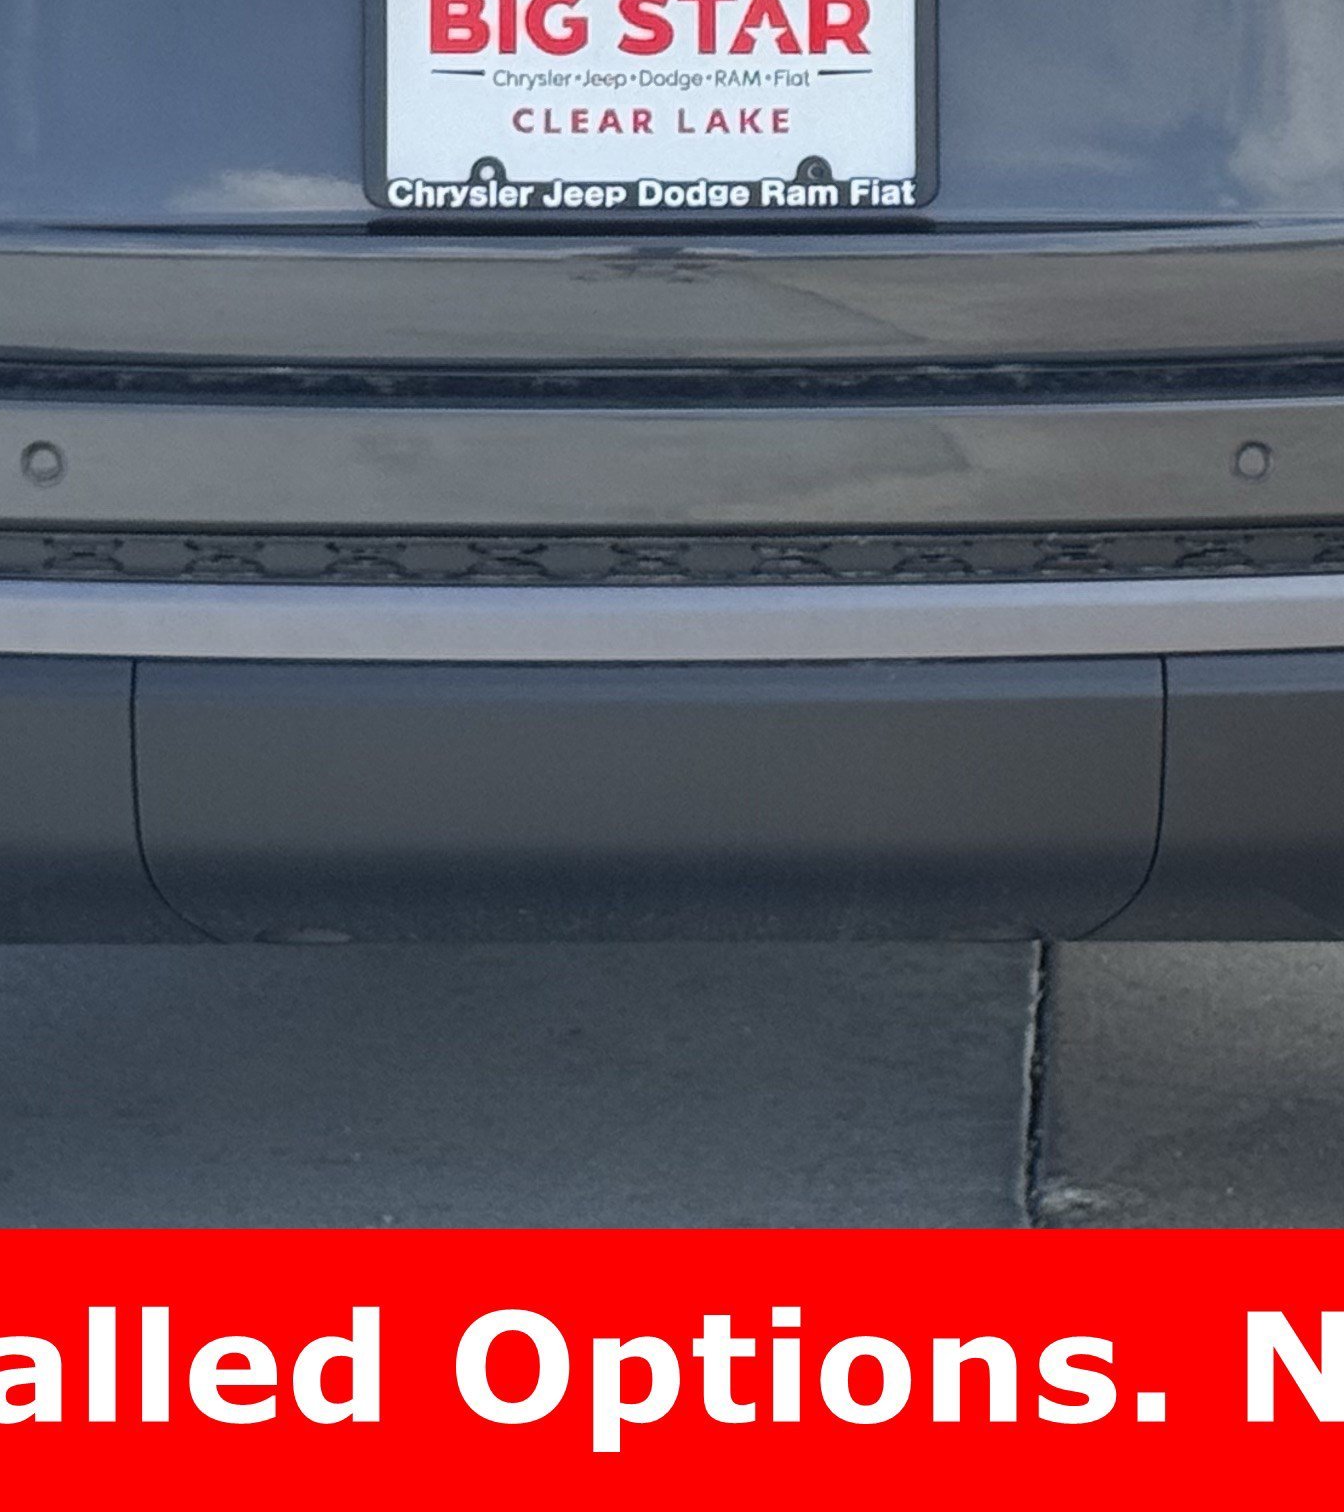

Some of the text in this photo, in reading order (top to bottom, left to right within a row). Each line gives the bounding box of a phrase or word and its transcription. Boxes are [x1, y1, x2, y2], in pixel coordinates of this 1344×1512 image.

[492, 69, 810, 91] Chrysler Jeep Dodge RAM Fiat
[512, 107, 791, 134] CLEAR LAKE
[387, 178, 916, 208] Chrysler Jeep Dodge Ram Fiat
